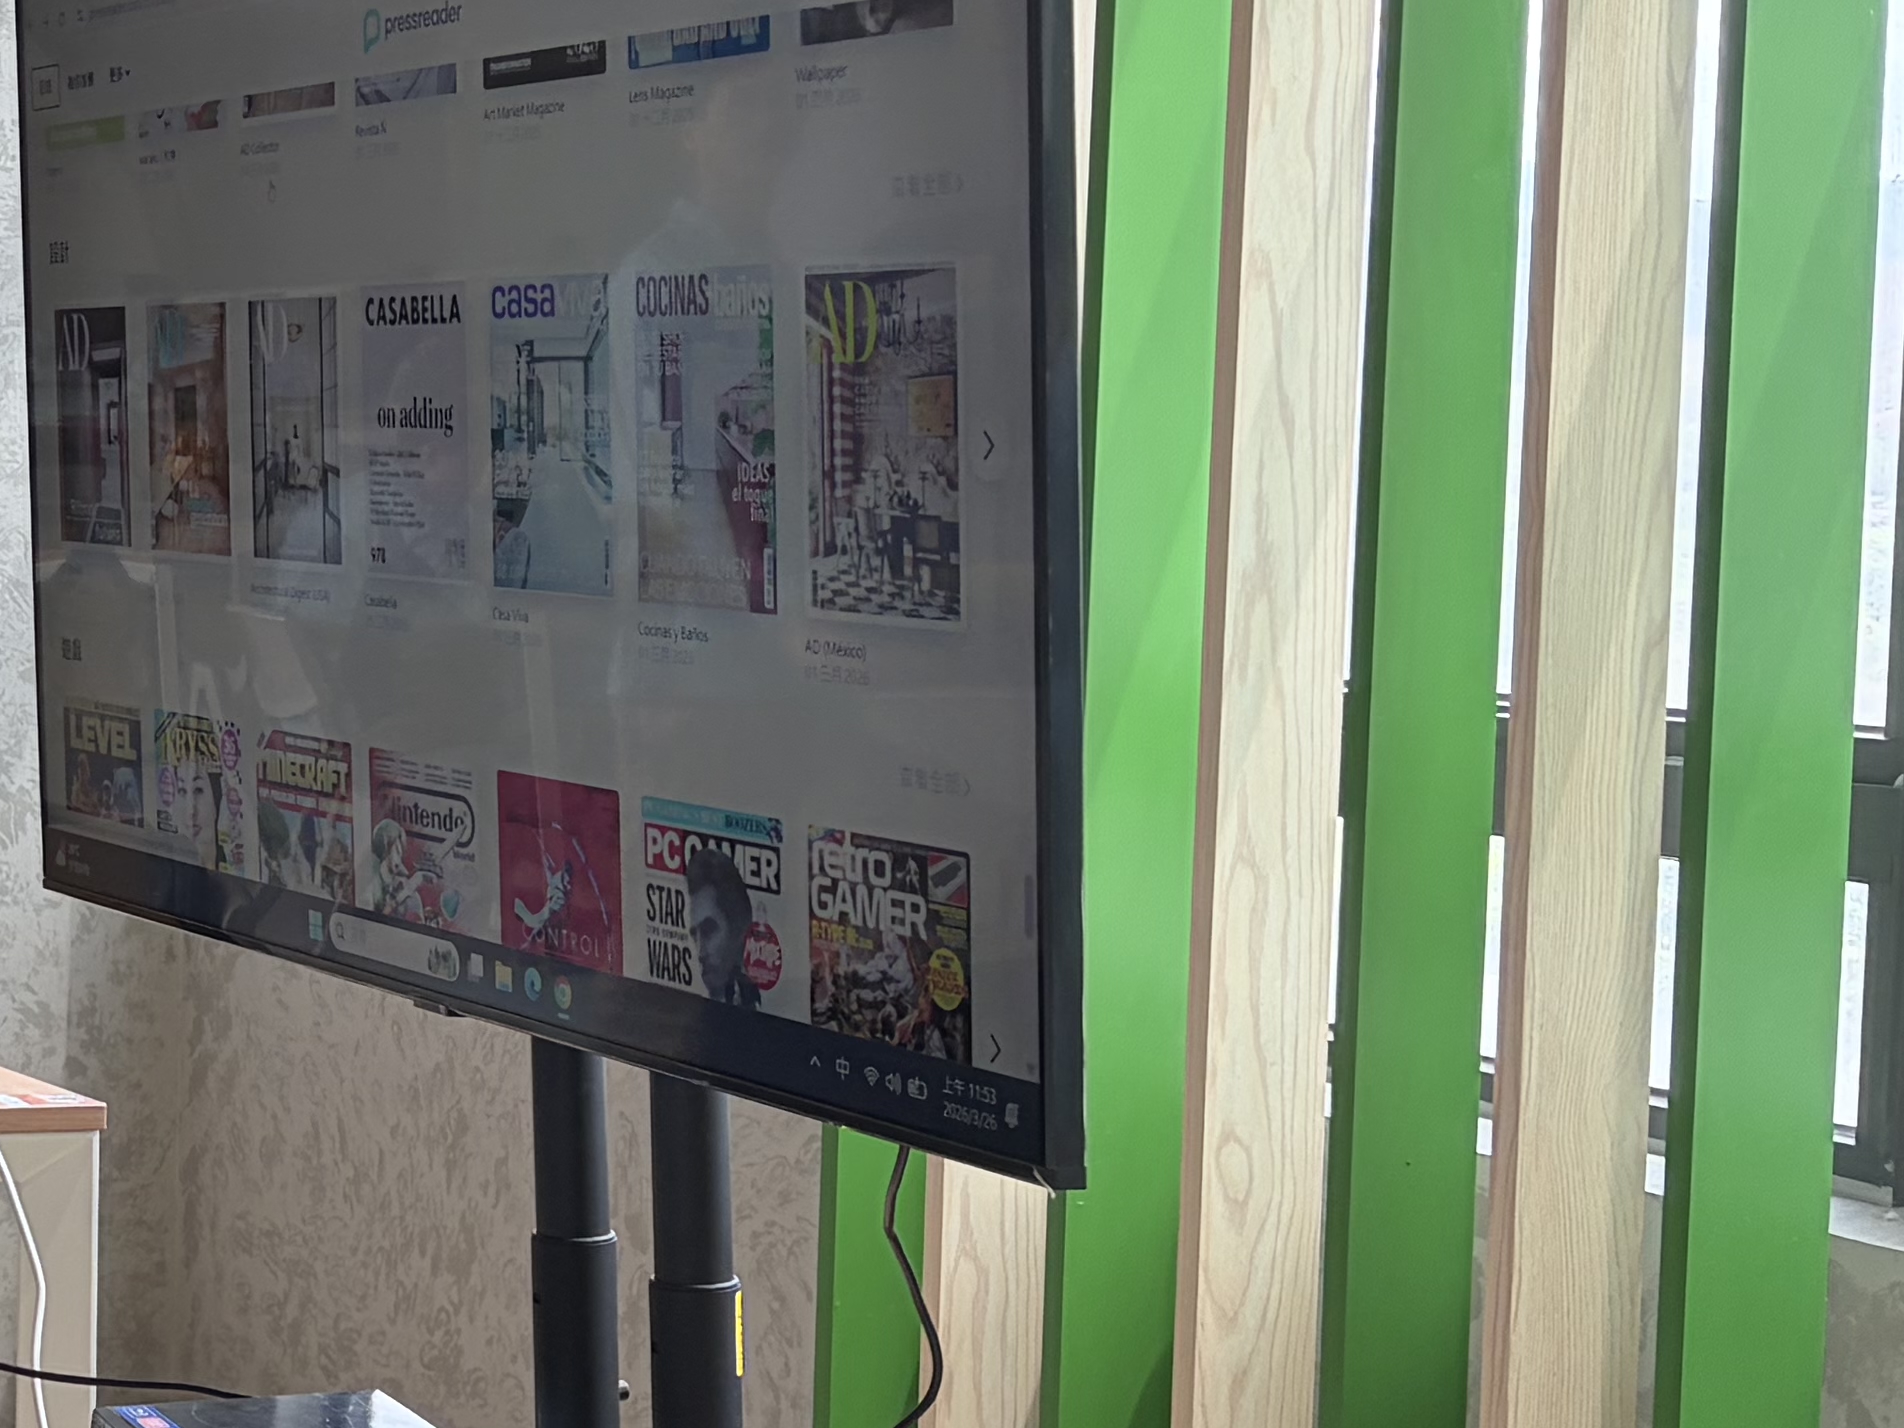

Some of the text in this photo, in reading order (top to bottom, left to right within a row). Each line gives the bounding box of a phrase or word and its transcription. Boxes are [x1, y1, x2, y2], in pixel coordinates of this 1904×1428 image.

[385, 2, 463, 40] pressreader
[794, 64, 849, 84] Wallpaper
[496, 105, 525, 120] Market
[526, 100, 566, 118] Magazine
[629, 84, 695, 104] Lens Magazine
[365, 293, 463, 327] CASABELLA
[491, 282, 556, 320] casa
[635, 273, 710, 318] COCINAS
[817, 280, 880, 364] AD
[377, 397, 454, 438] on adding
[637, 621, 671, 642] Cocinas
[804, 638, 868, 662] AD (México)
[69, 713, 137, 761] LEVEL
[257, 749, 350, 800] MINECRAFT
[646, 826, 681, 871] PC
[811, 829, 893, 888] retro
[646, 882, 686, 930] STAR
[810, 876, 928, 941] GAMER
[521, 922, 601, 959] CONTROL
[646, 937, 693, 987] WARS
[835, 1056, 850, 1081] 中
[942, 1075, 965, 1097] 上午
